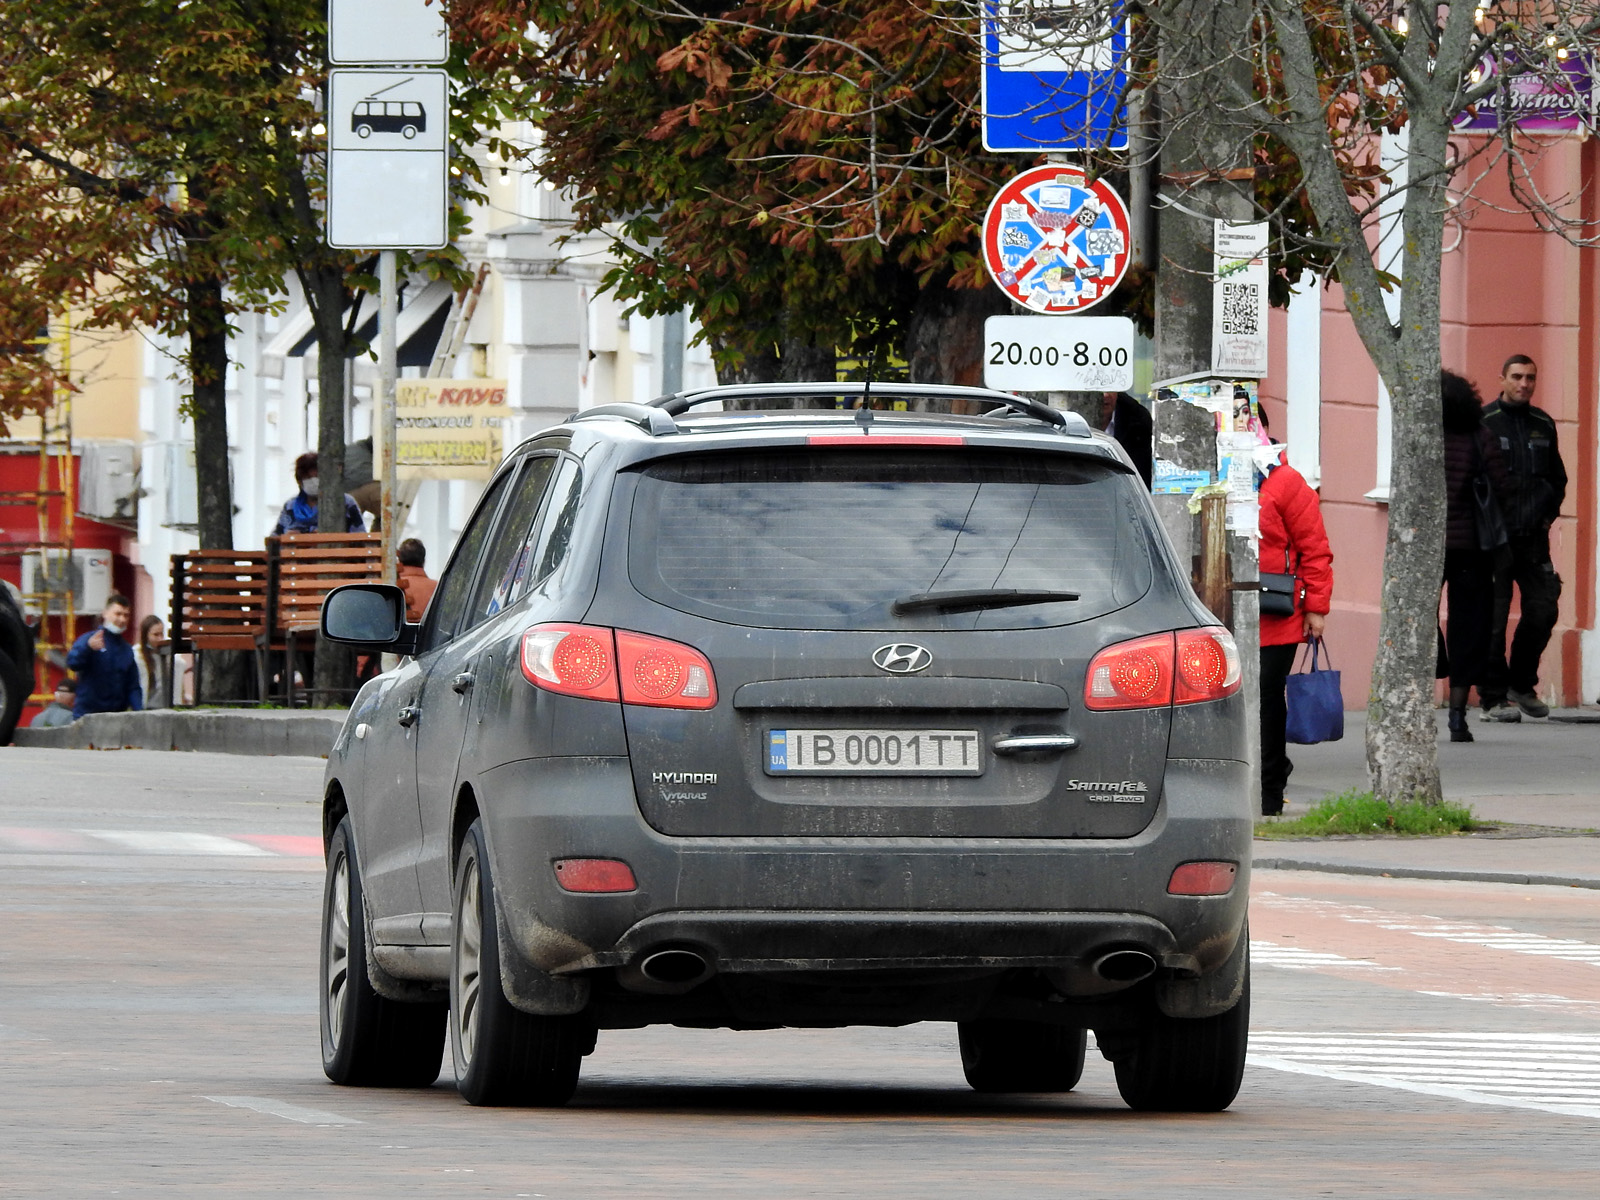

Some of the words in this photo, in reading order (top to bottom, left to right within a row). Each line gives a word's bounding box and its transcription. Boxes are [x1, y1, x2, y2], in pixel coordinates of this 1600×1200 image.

[989, 341, 1128, 367] 20.00-8.00
[771, 755, 786, 766] UA
[652, 772, 718, 784] HYUNDAI
